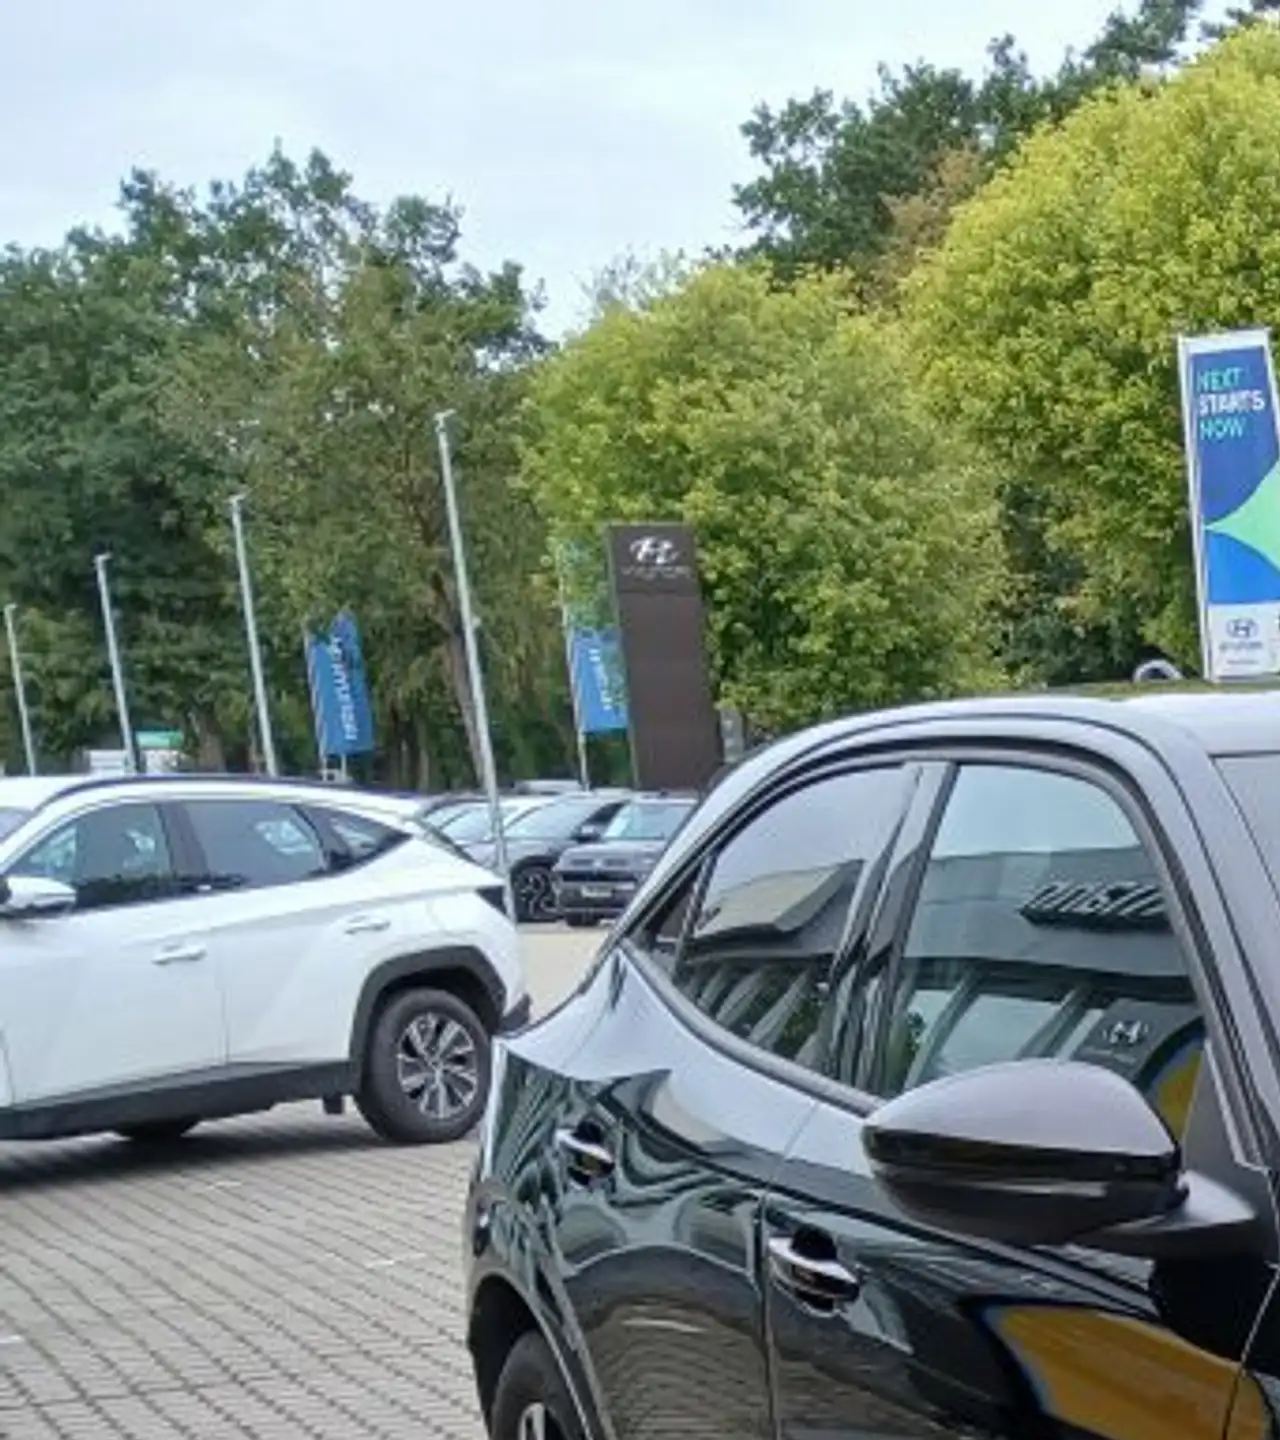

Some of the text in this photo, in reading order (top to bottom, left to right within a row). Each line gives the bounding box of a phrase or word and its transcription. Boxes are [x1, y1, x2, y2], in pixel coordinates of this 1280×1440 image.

[1197, 367, 1242, 391] NEXT
[1199, 390, 1265, 415] STARTS
[1200, 416, 1246, 440] NOW
